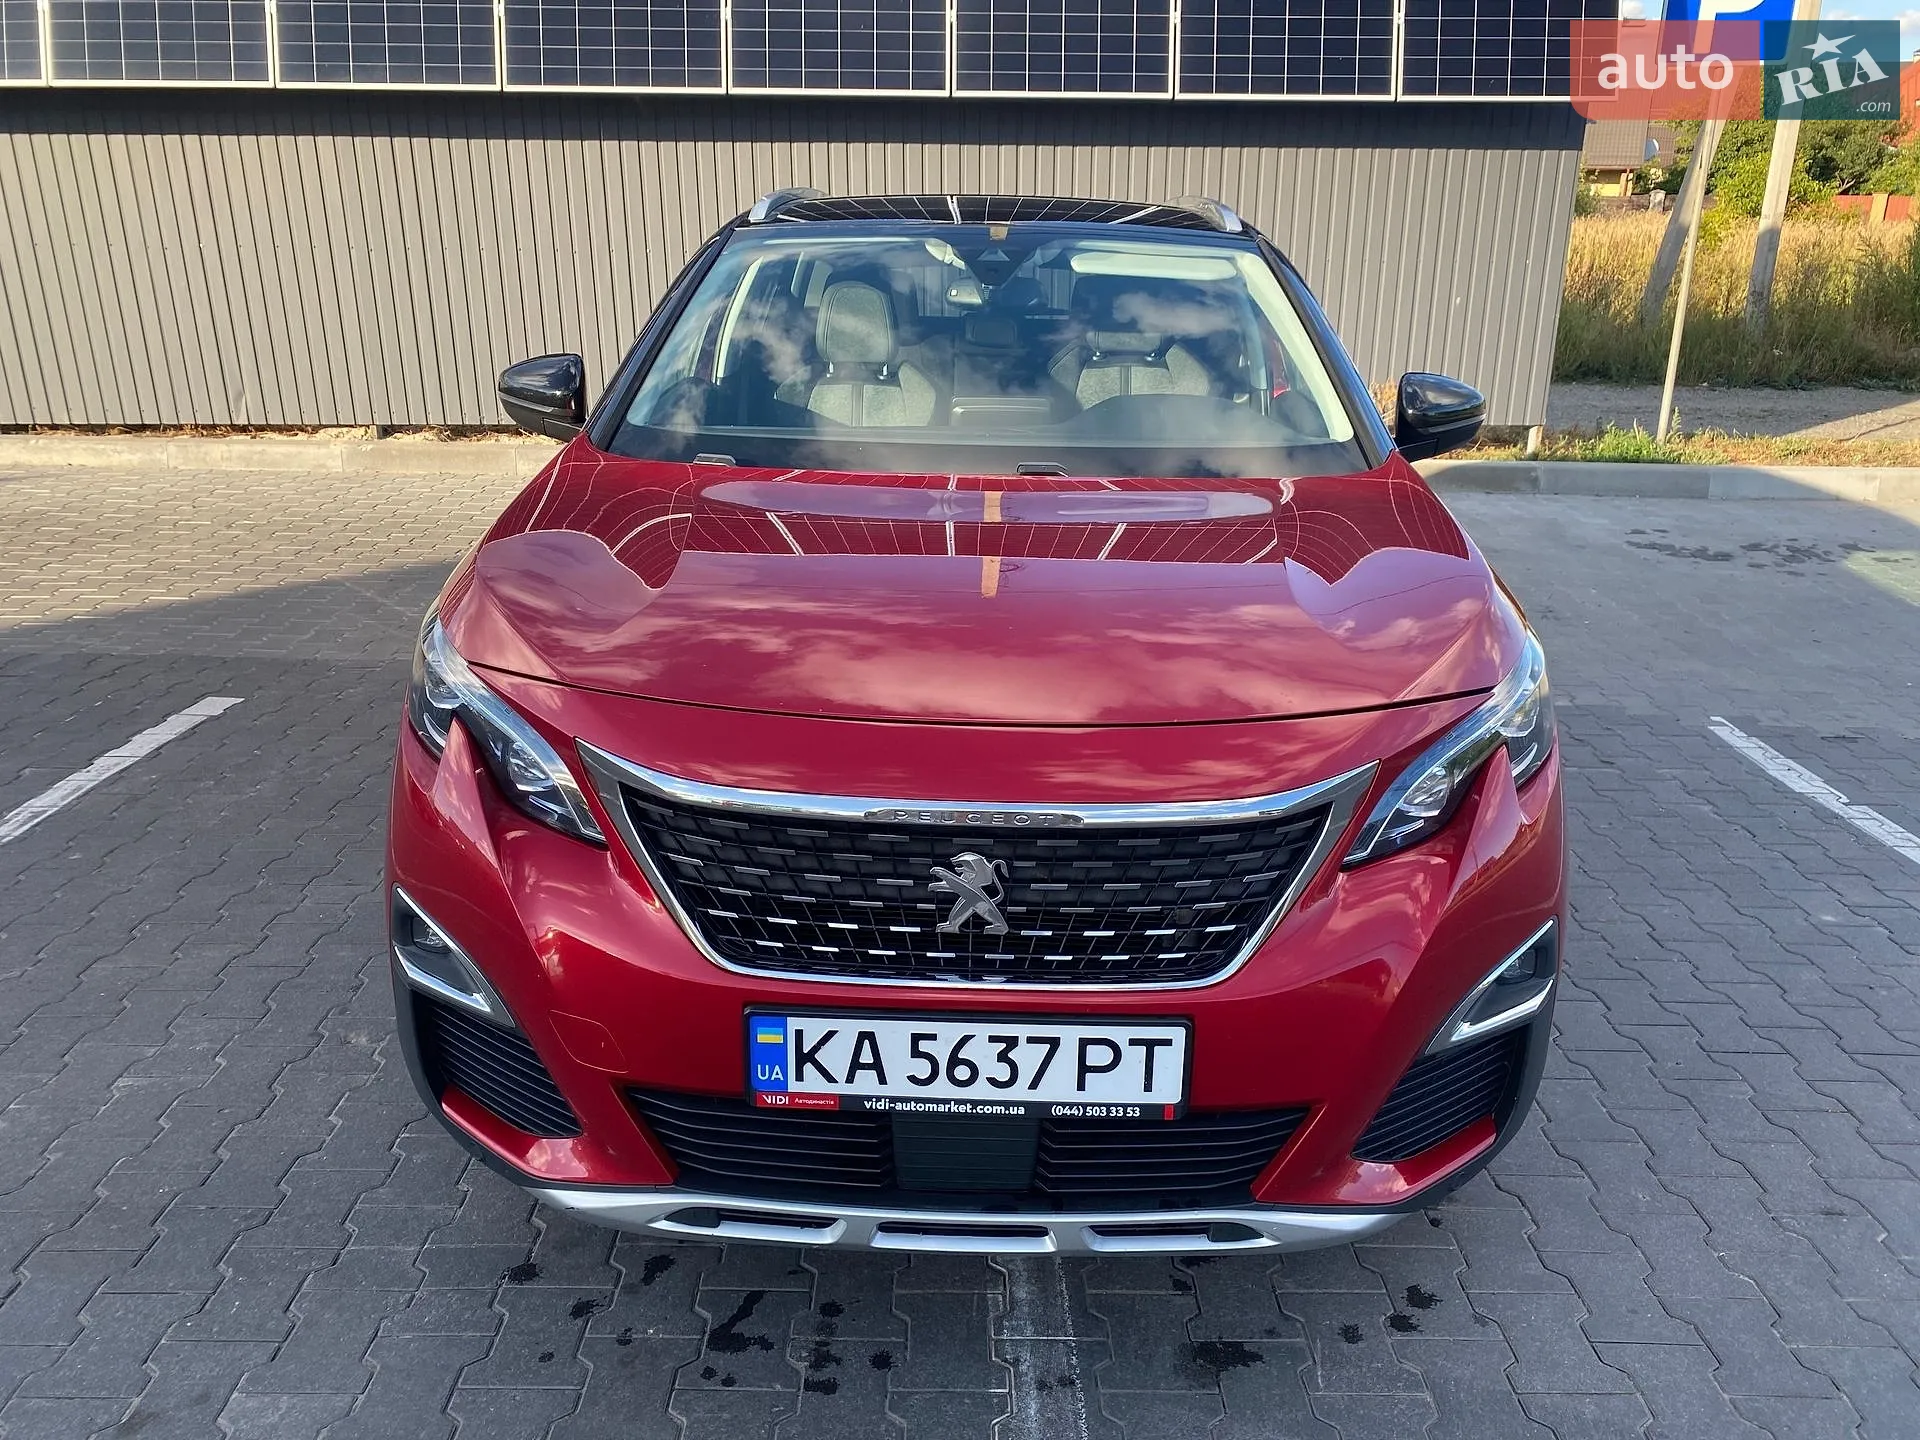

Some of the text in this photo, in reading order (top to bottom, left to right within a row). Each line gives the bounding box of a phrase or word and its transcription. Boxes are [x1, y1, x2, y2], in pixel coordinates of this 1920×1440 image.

[794, 1029, 1173, 1093] KA 5637 PT
[757, 1064, 784, 1081] UA
[762, 1095, 789, 1105] VIDI
[863, 1098, 1025, 1115] vidi-automarket.com.ua
[1051, 1105, 1141, 1118] (044) 503 33 53
